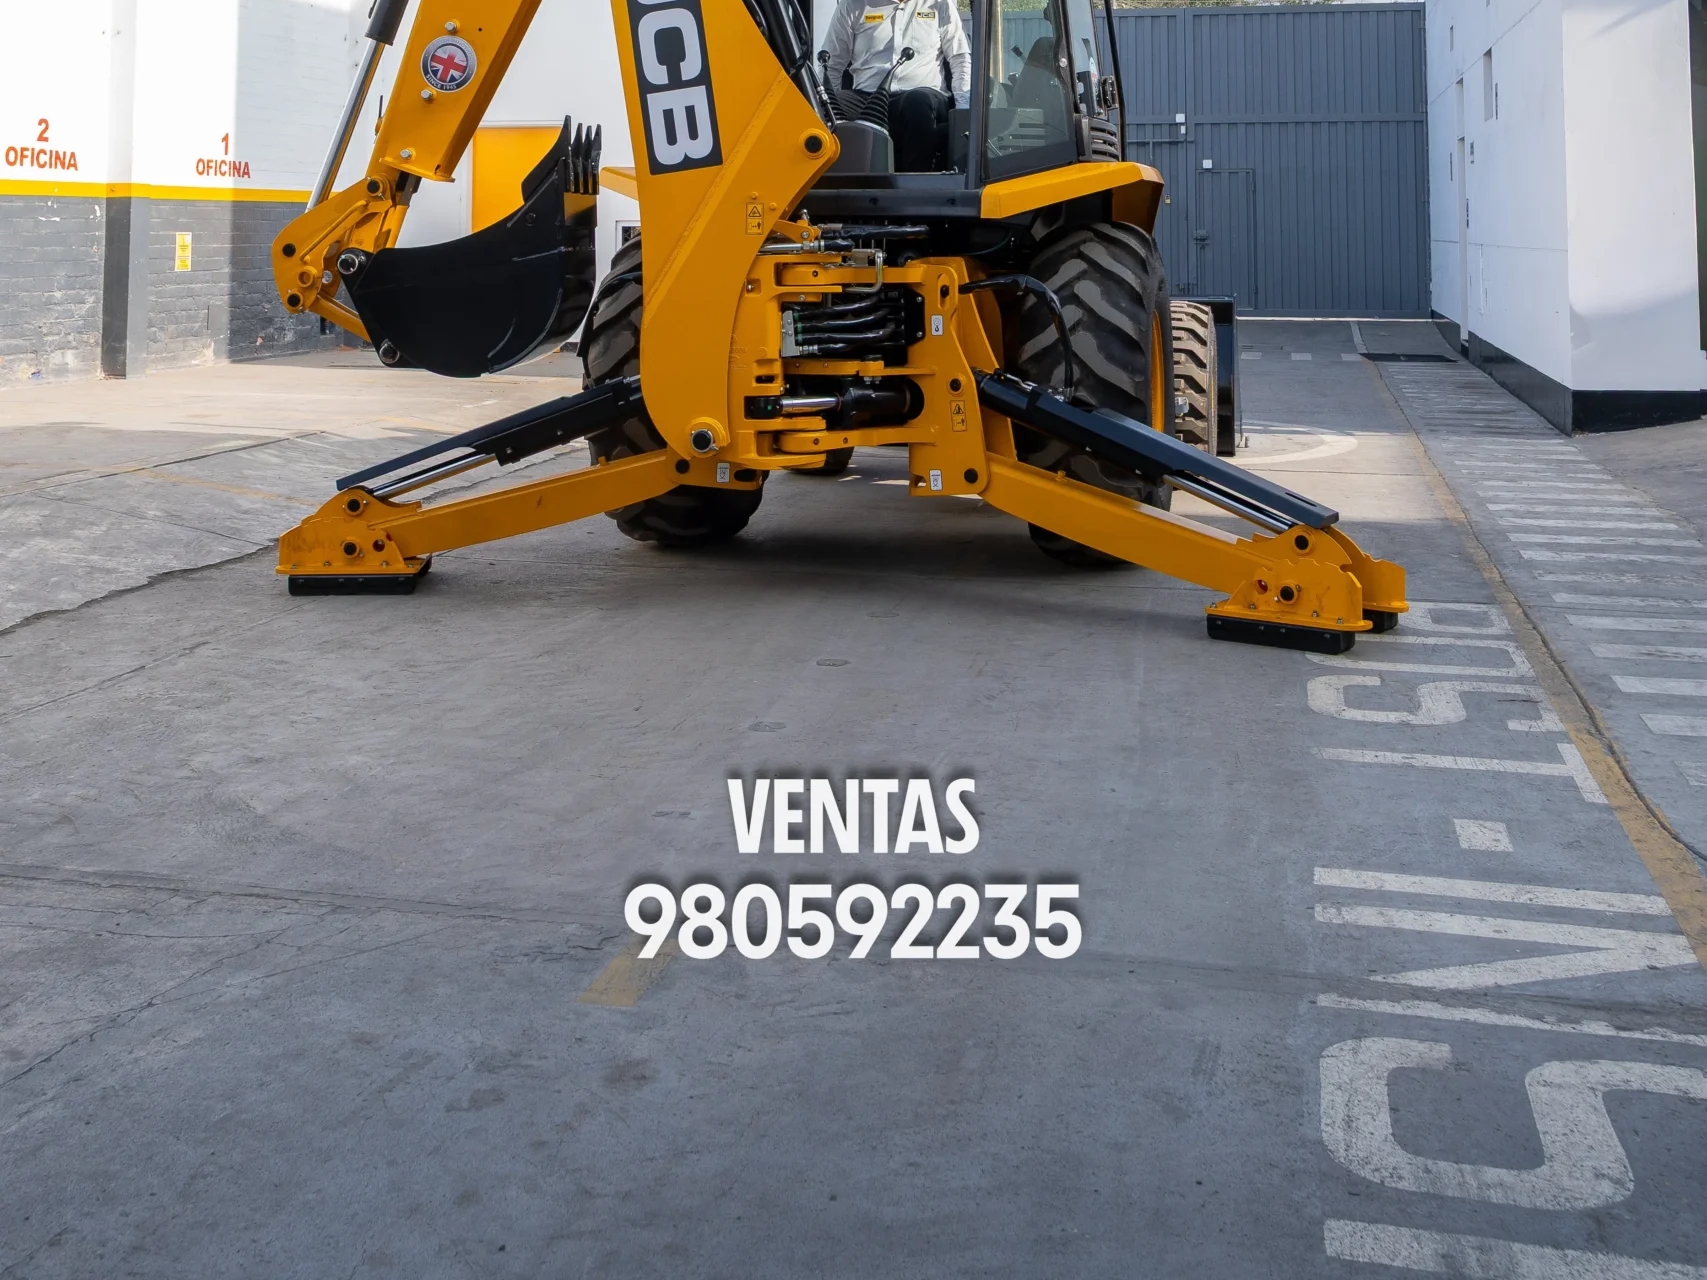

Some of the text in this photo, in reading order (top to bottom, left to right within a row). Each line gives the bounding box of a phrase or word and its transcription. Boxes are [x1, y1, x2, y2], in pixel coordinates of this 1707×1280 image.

[425, 73, 442, 89] SINCE
[37, 118, 49, 142] 2
[221, 132, 229, 155] 1
[5, 146, 78, 171] OFICINA
[196, 158, 251, 178] OFICINA
